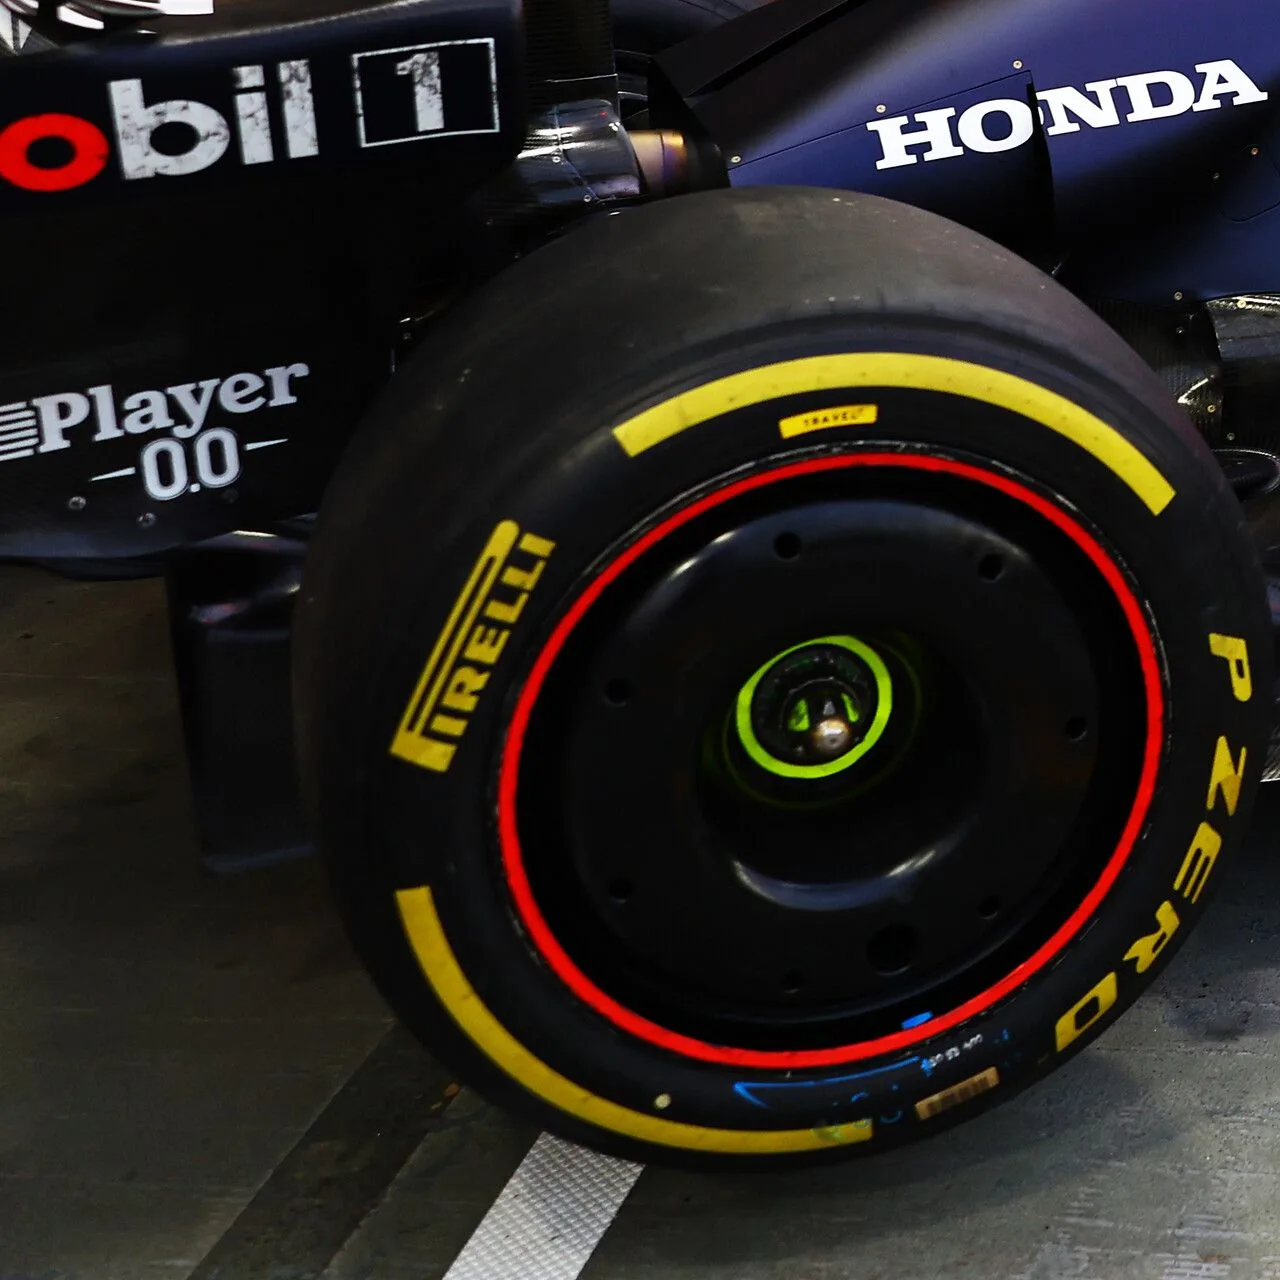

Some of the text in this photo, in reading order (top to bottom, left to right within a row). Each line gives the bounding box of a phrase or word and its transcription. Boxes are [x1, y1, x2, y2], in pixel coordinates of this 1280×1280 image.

[866, 58, 1269, 171] HONDA
[33, 359, 310, 454] Player
[139, 425, 242, 503] 0.0
[389, 519, 557, 773] PIRELLI
[1054, 631, 1254, 1054] P ZERO
